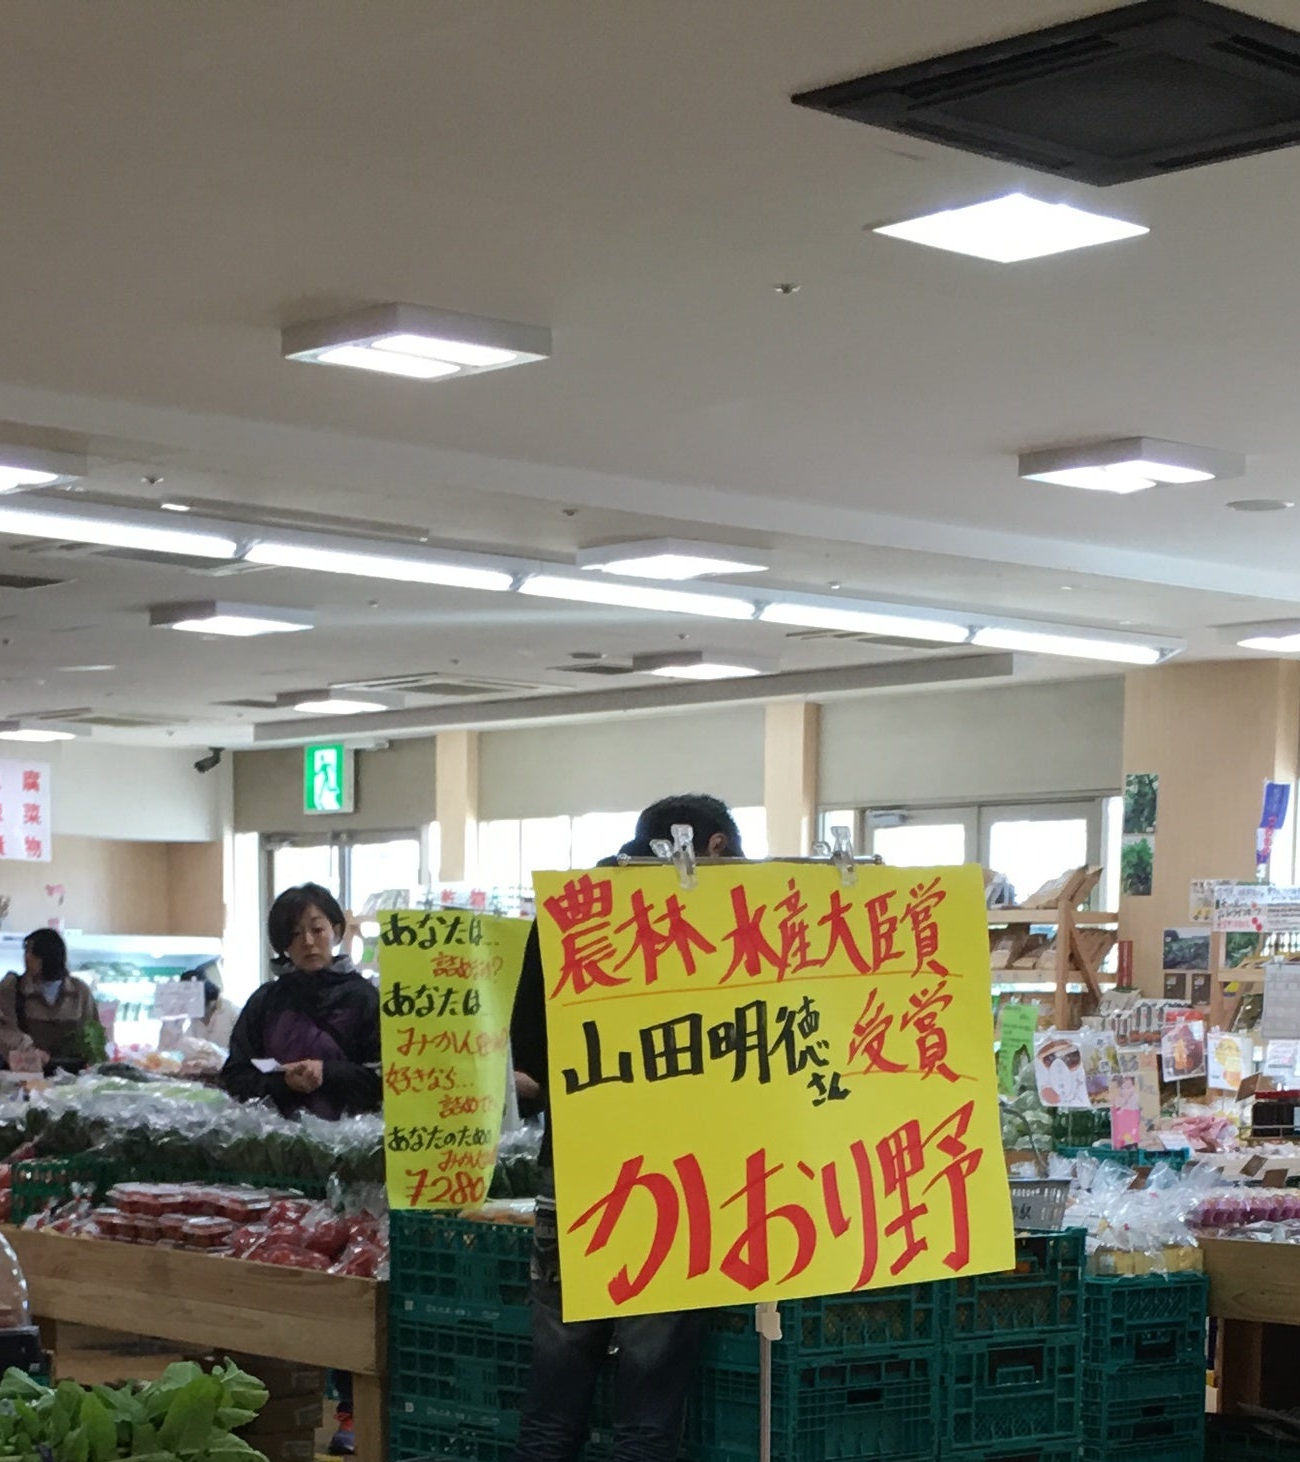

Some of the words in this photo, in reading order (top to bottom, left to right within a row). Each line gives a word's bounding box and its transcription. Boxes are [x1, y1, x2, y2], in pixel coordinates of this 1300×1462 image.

[545, 872, 951, 1003] 農林水産大臣賞
[562, 994, 823, 1096] 山田明徳
[847, 987, 961, 1084] 受賞
[564, 1099, 993, 1306] かおり野
